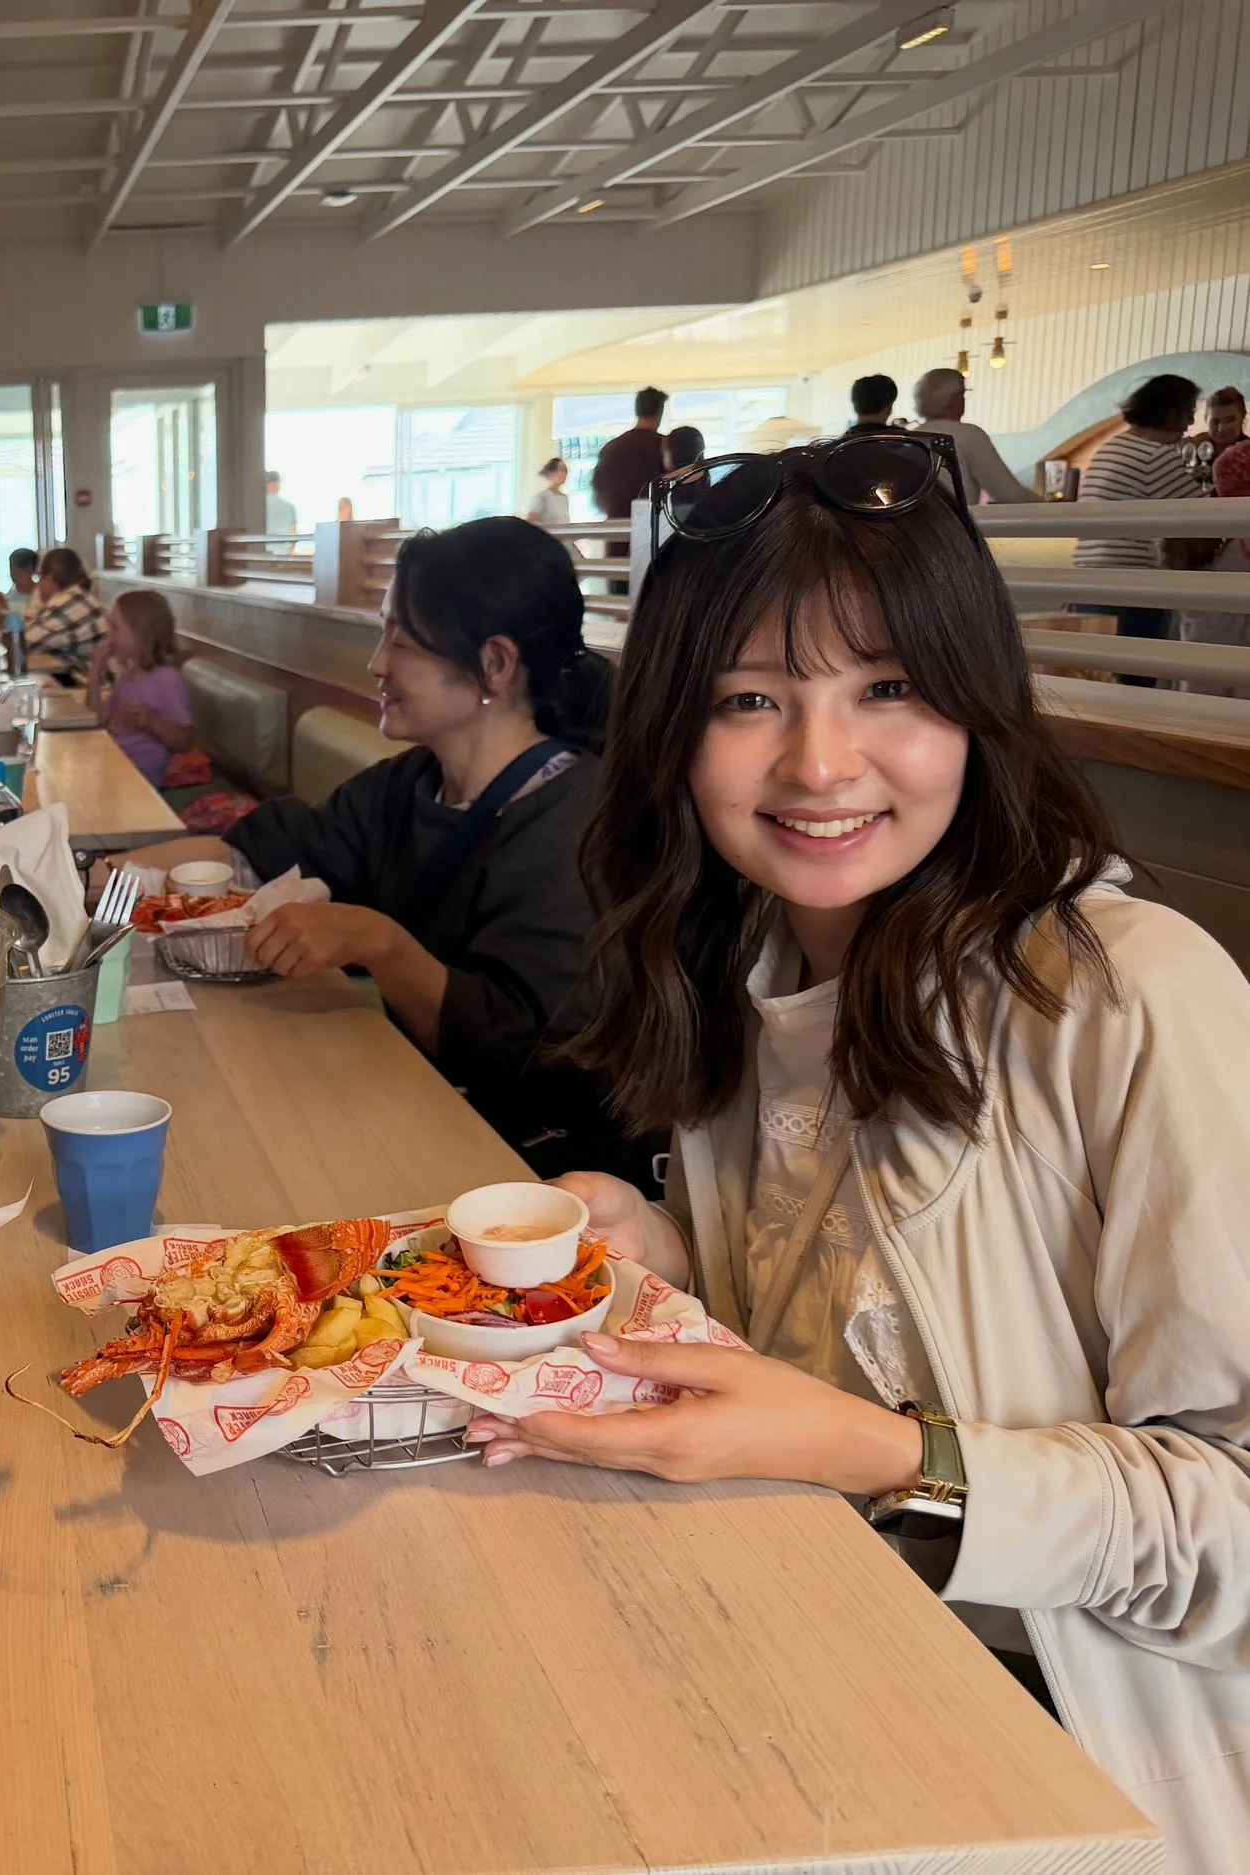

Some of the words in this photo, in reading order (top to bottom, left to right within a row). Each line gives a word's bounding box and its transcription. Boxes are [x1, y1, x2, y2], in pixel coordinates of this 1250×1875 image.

[20, 1044, 39, 1052] order
[23, 1055, 37, 1063] pay
[48, 1066, 70, 1085] 95
[62, 1274, 94, 1292] SHACK
[418, 1357, 456, 1373] SHACK
